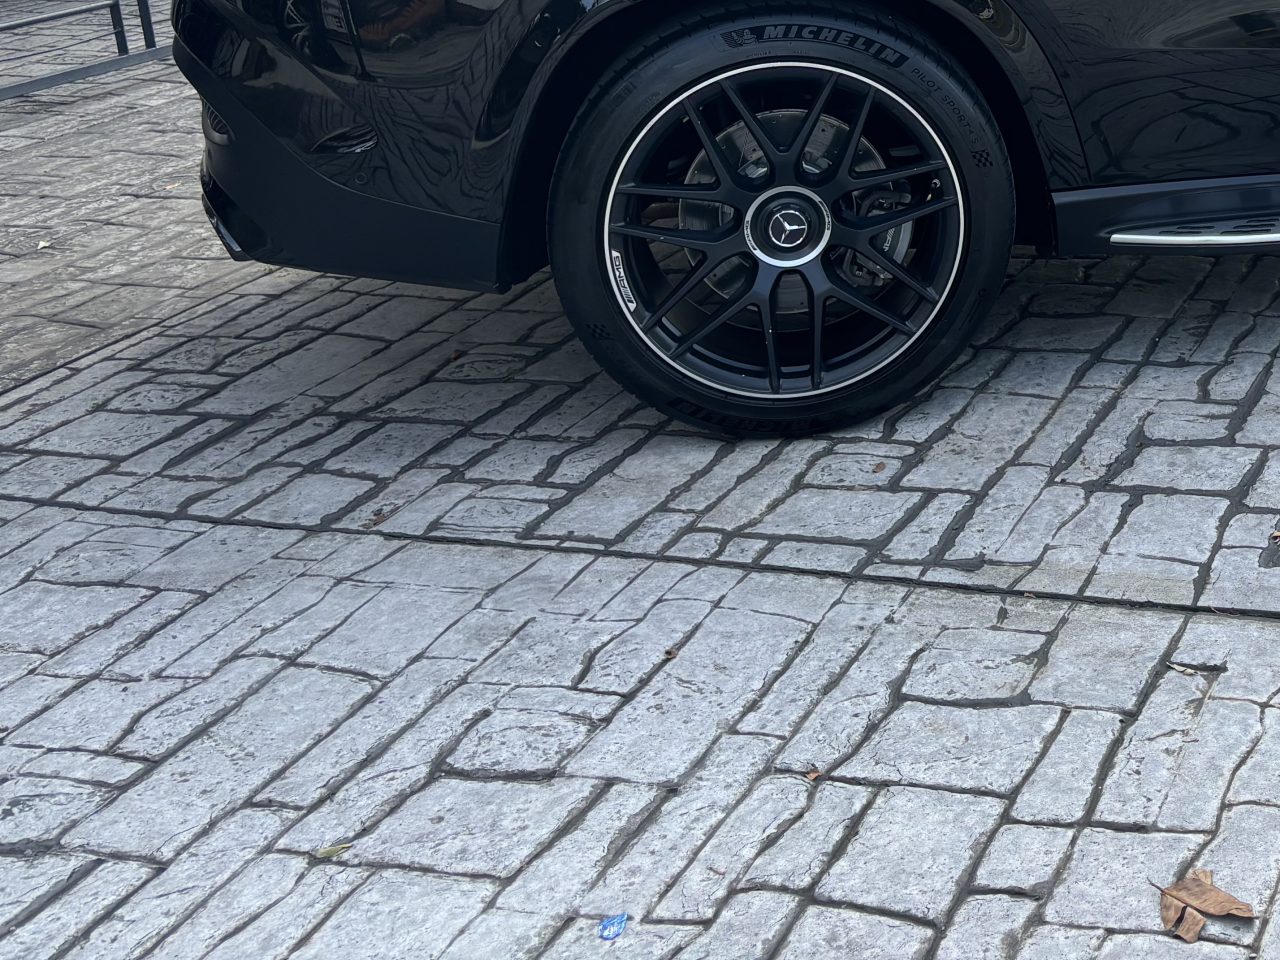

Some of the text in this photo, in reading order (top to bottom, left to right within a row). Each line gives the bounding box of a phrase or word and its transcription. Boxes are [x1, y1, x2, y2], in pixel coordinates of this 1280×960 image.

[763, 25, 901, 64] MICHELIN
[911, 67, 943, 93] PILOT
[943, 95, 971, 128] SPORT
